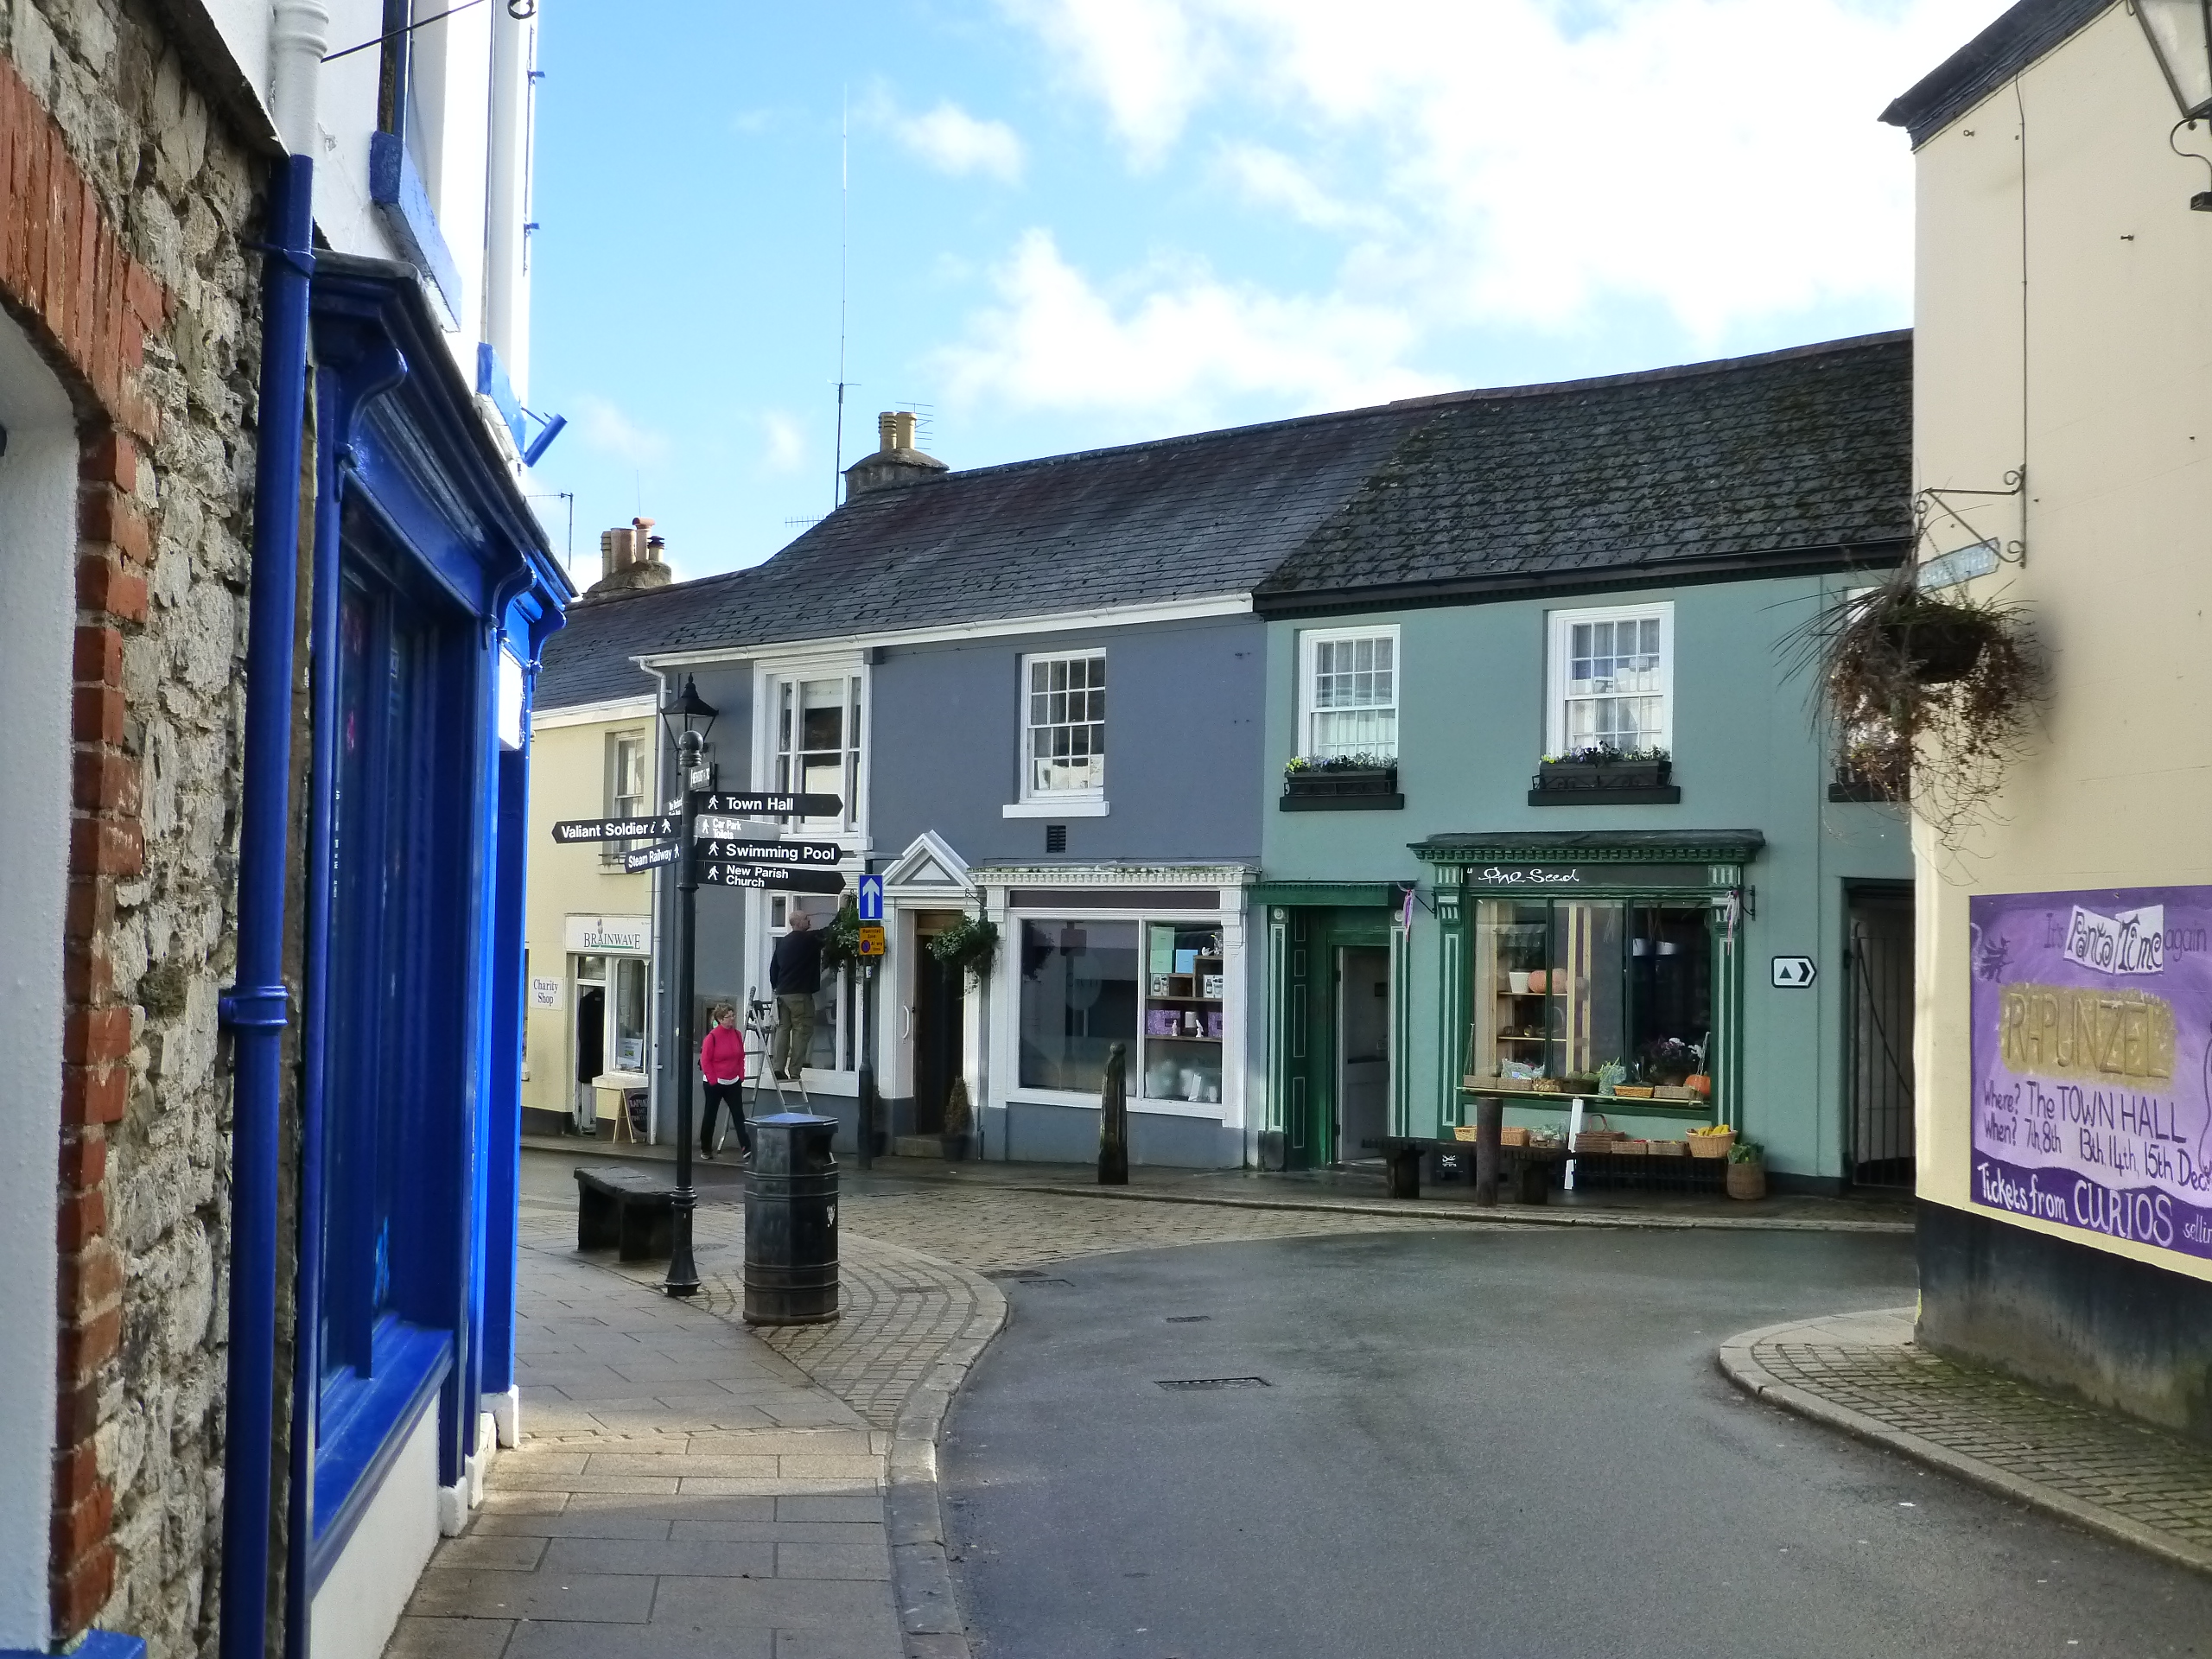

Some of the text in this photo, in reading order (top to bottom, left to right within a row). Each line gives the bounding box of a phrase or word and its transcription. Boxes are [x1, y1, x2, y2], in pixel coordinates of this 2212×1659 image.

[726, 797, 794, 810] Town Hall
[562, 824, 601, 838] Valiant
[605, 822, 649, 836] Soldier
[713, 817, 741, 831] Car Park
[713, 828, 734, 840] Toilets
[628, 848, 673, 868] Steam Railway
[726, 843, 836, 861] Swimming Pool
[727, 864, 789, 880] New Parish
[1526, 868, 1580, 884] Seed
[726, 874, 766, 887] Church
[584, 932, 641, 950] BRAINWAVE
[2164, 919, 2208, 963] again
[533, 978, 559, 994] Charity
[537, 993, 554, 1007] Shop
[2005, 993, 2171, 1079] RAPUNZEL
[1983, 1079, 2188, 1144] Where? The TOWN HALL
[1984, 1111, 2018, 1147] When?
[2144, 1141, 2175, 1183] 15th
[1977, 1162, 2029, 1211] Tickets
[2029, 1173, 2069, 1223] from
[2074, 1179, 2175, 1248] CURIOS
